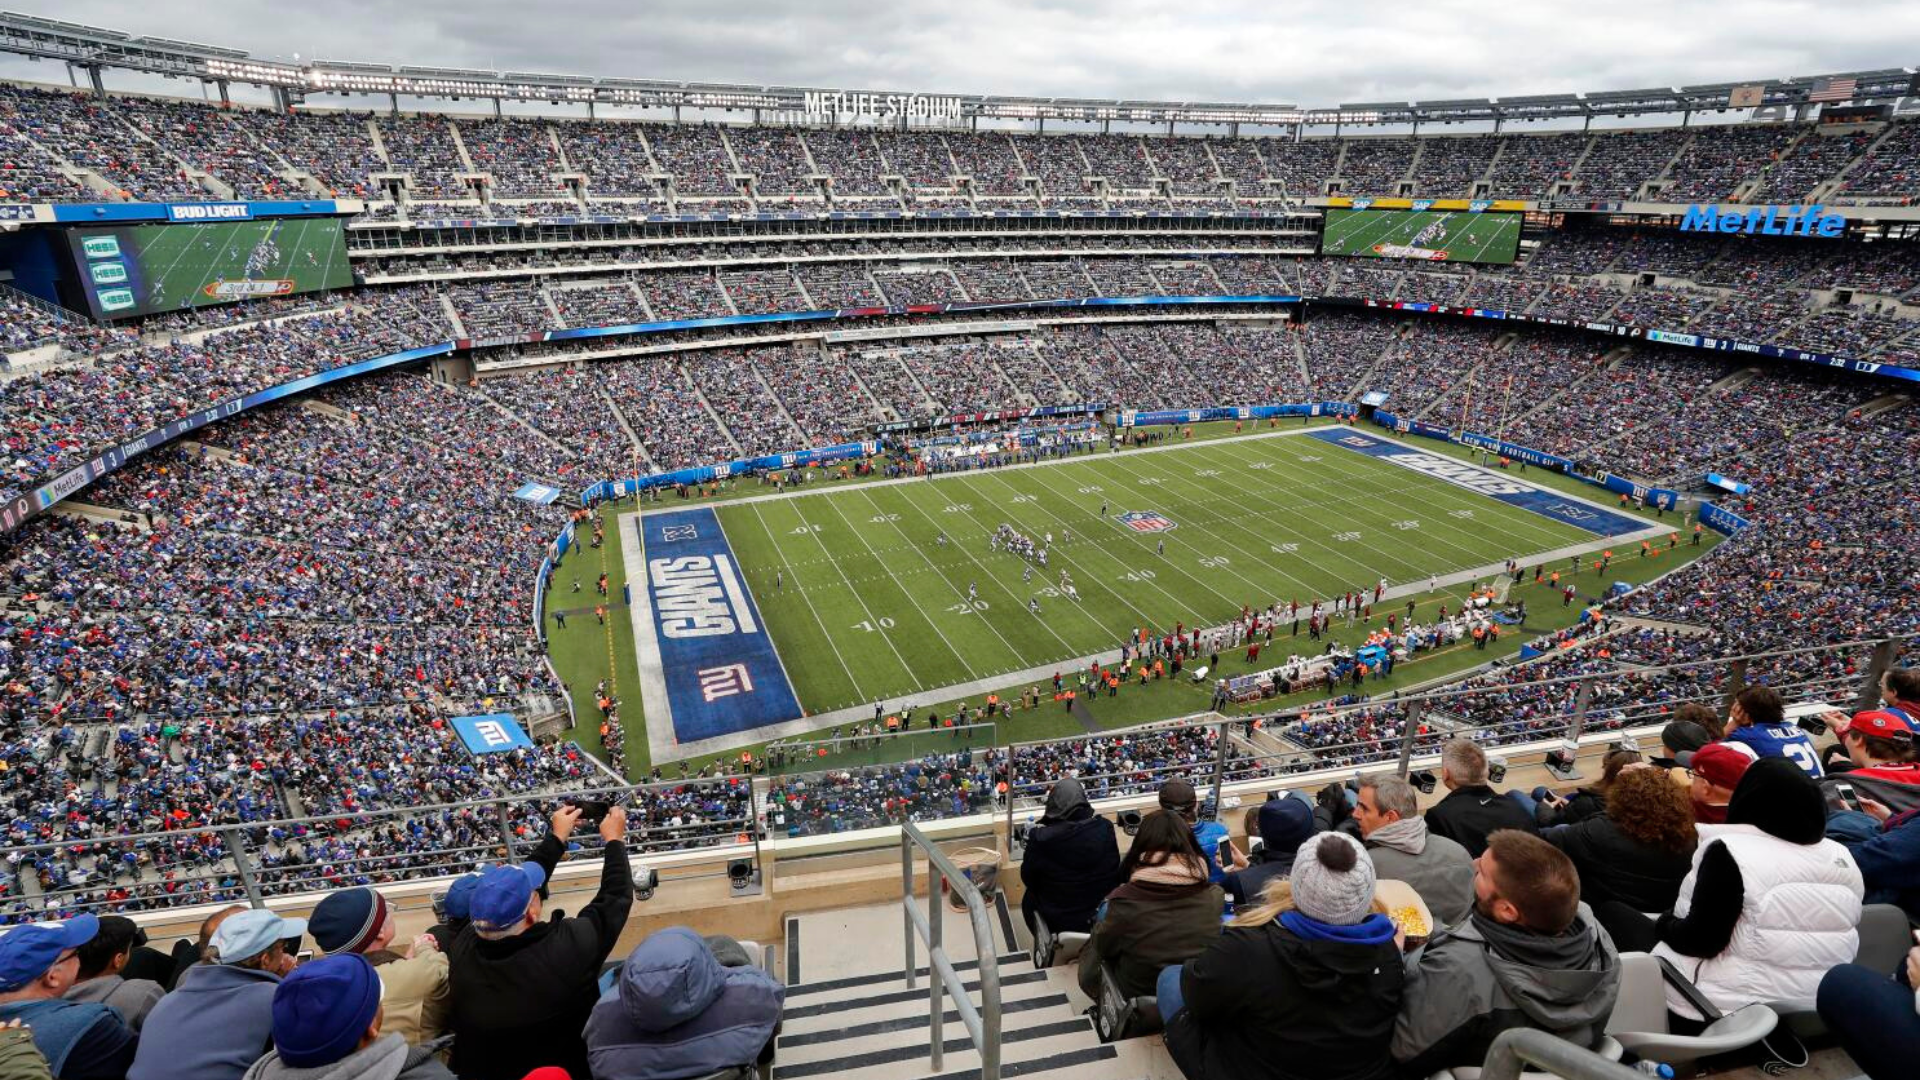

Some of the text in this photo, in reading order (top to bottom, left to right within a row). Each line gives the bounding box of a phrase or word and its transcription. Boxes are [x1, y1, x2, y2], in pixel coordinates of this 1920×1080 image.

[804, 92, 961, 119] METLIFE STADIUM
[172, 204, 249, 219] BUD LIGHT
[1352, 200, 1370, 209] SAP
[1412, 201, 1430, 210] SAP
[1469, 202, 1488, 212] SAP
[1680, 203, 1846, 238] MetLife
[1503, 446, 1540, 463] FOOTBALL
[54, 472, 86, 497] MetLife
[1200, 556, 1230, 568] 50
[1126, 569, 1156, 582] 40
[650, 556, 736, 638] GIANTS
[958, 600, 990, 615] 20
[858, 616, 896, 632] 10
